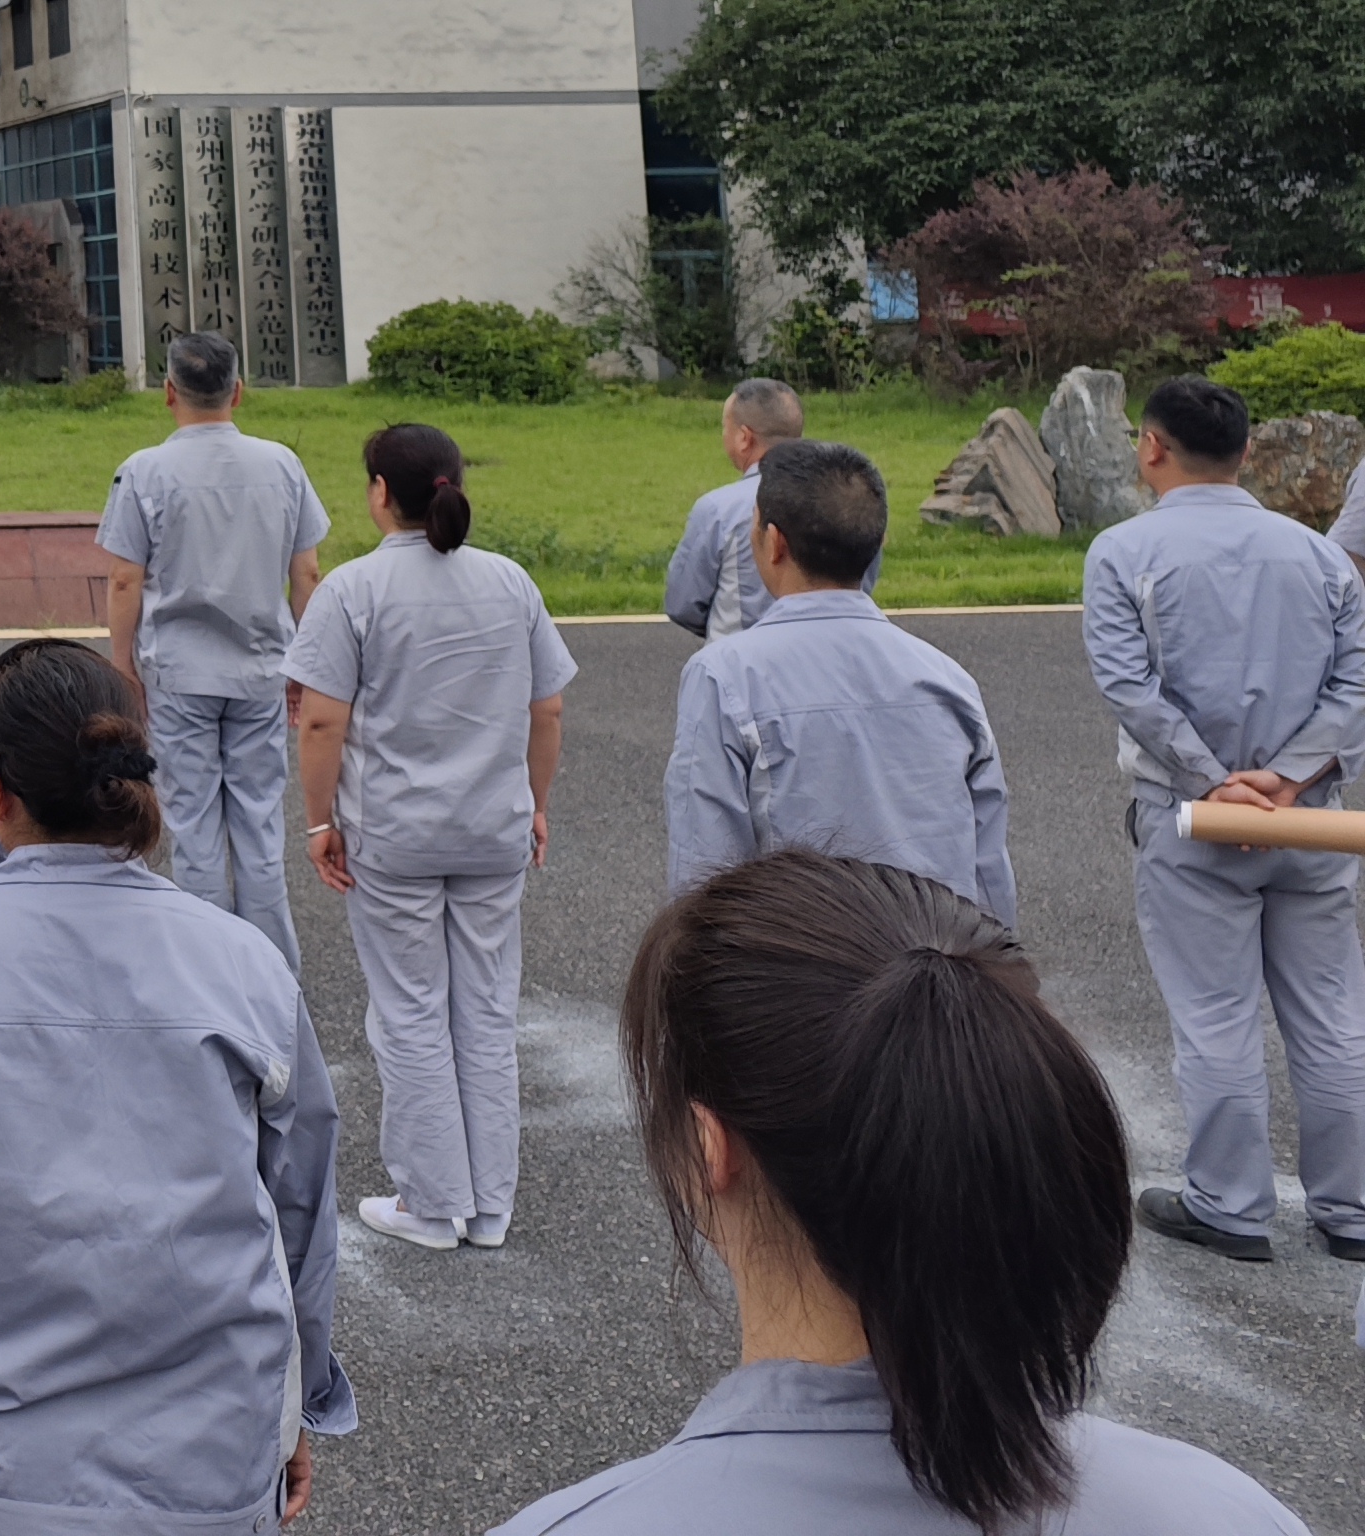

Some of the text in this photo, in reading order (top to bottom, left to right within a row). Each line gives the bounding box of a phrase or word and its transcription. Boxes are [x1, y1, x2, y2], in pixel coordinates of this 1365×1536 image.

[144, 115, 183, 373] 国家高新技术企
[195, 115, 237, 344] 贵州省专精特新中小
[246, 113, 287, 378] 贵州省产学研结合示范基地
